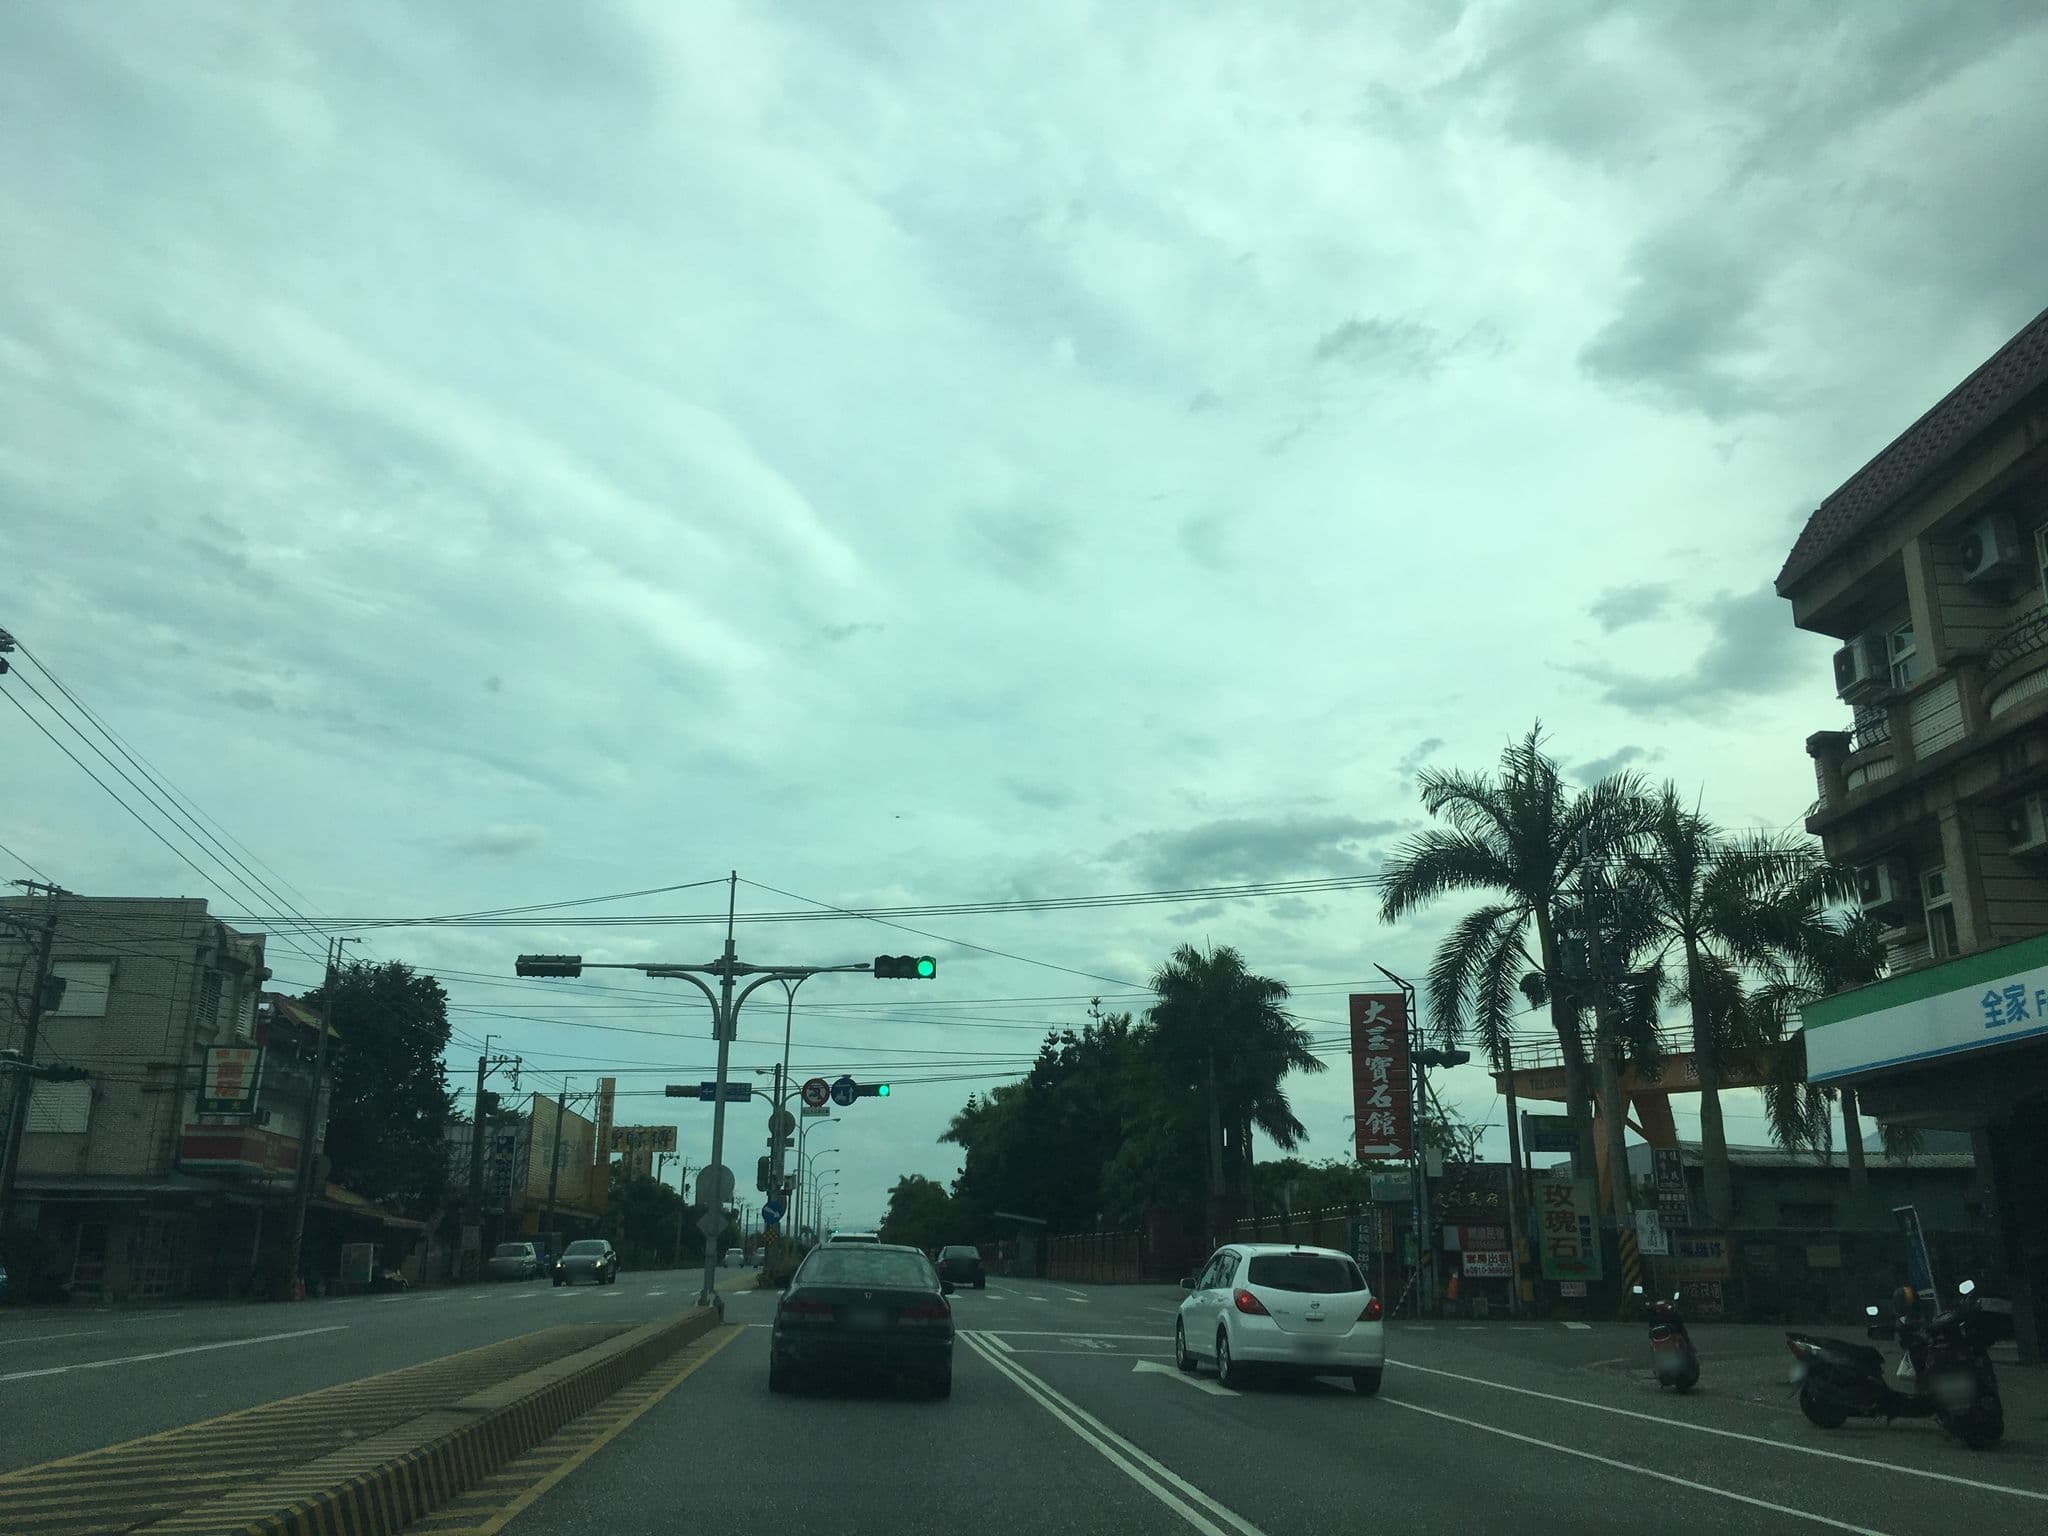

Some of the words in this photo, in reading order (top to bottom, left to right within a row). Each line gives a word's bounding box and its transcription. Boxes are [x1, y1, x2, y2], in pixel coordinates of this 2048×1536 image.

[1982, 984, 2030, 1028] 全家
[1542, 1184, 1577, 1258] 玫瑰石
